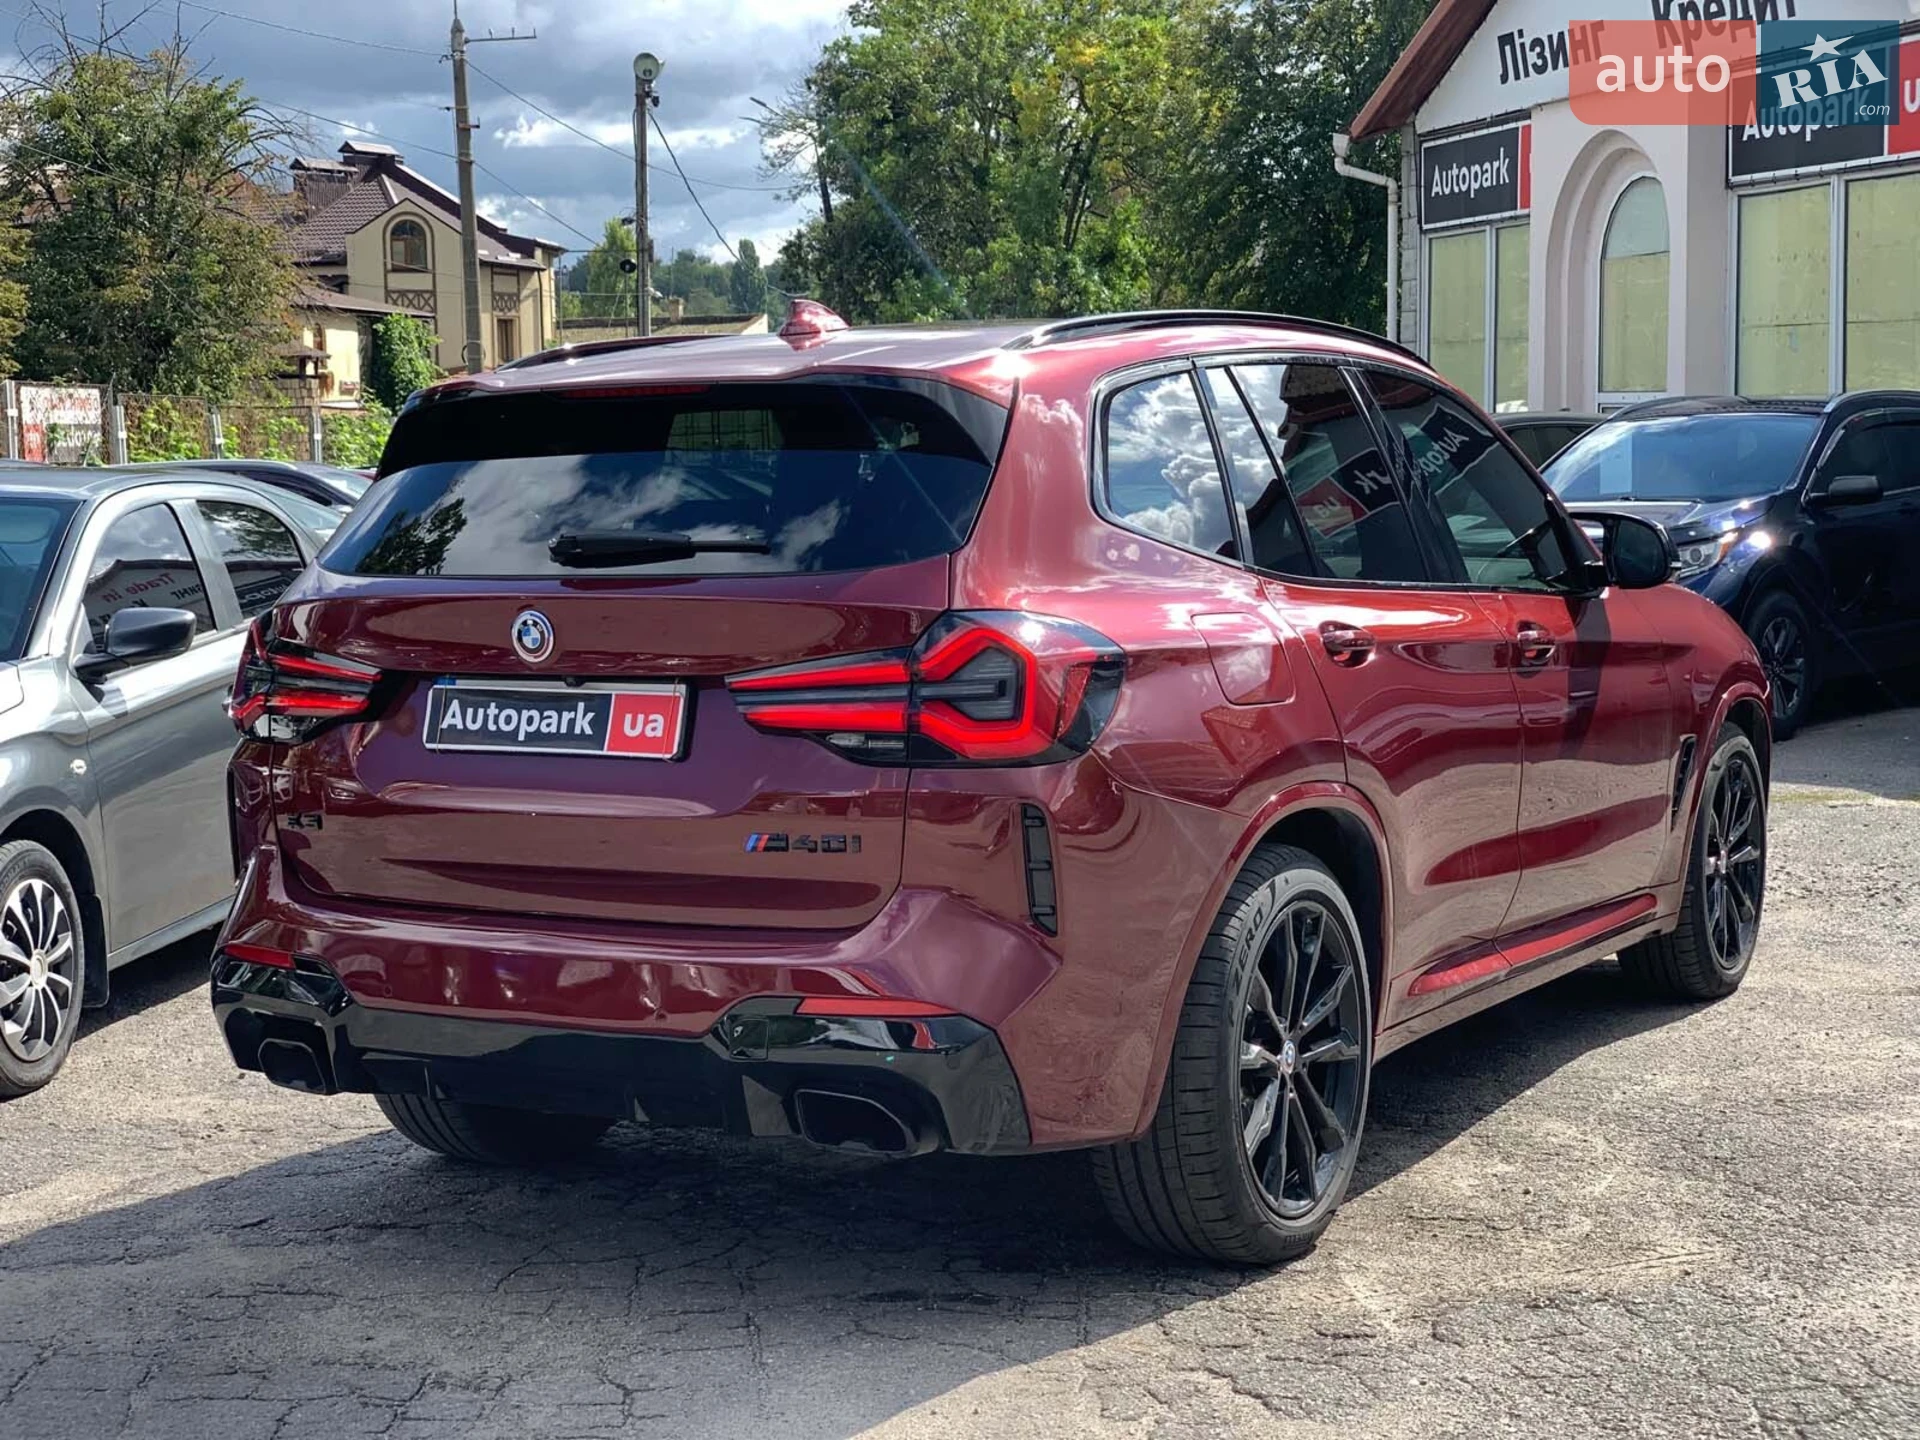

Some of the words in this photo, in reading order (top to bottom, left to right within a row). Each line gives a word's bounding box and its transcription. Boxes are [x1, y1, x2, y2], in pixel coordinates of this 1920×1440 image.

[1497, 20, 1605, 85] Лізинг
[1431, 147, 1510, 199] Autopark
[441, 699, 596, 741] Autopark
[623, 711, 665, 738] ua
[1232, 906, 1264, 996] ZERO
